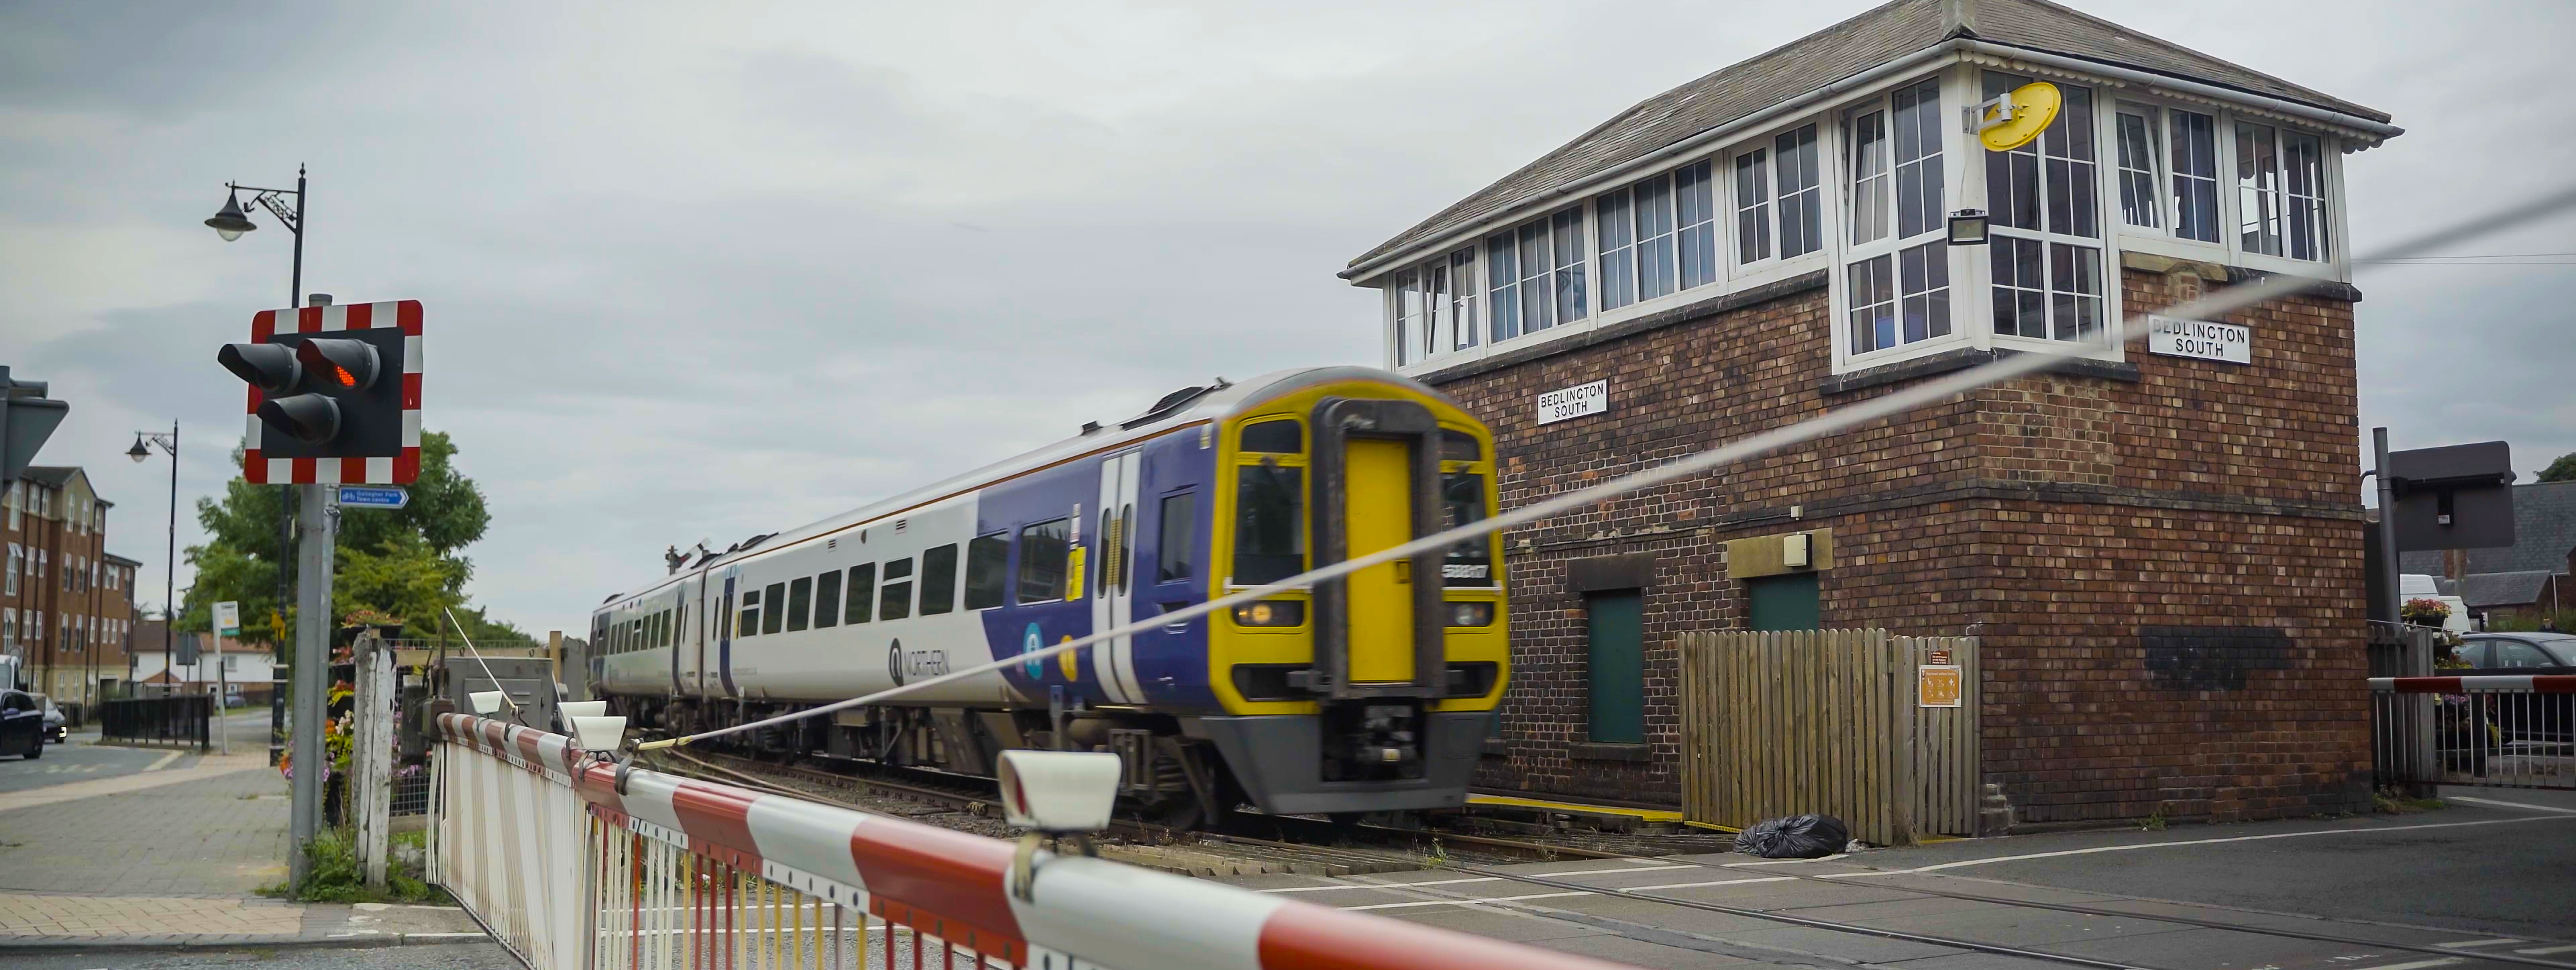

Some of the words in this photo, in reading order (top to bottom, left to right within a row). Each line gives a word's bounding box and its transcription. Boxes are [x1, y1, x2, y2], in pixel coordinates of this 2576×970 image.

[2152, 319, 2245, 343] BEDLINGTON
[2176, 338, 2224, 357] SOUTH
[1540, 383, 1603, 408] BEDLINGTON
[1554, 400, 1588, 418] SOUTH
[356, 490, 384, 498] Gallagher
[904, 649, 951, 676] NORTHERN
